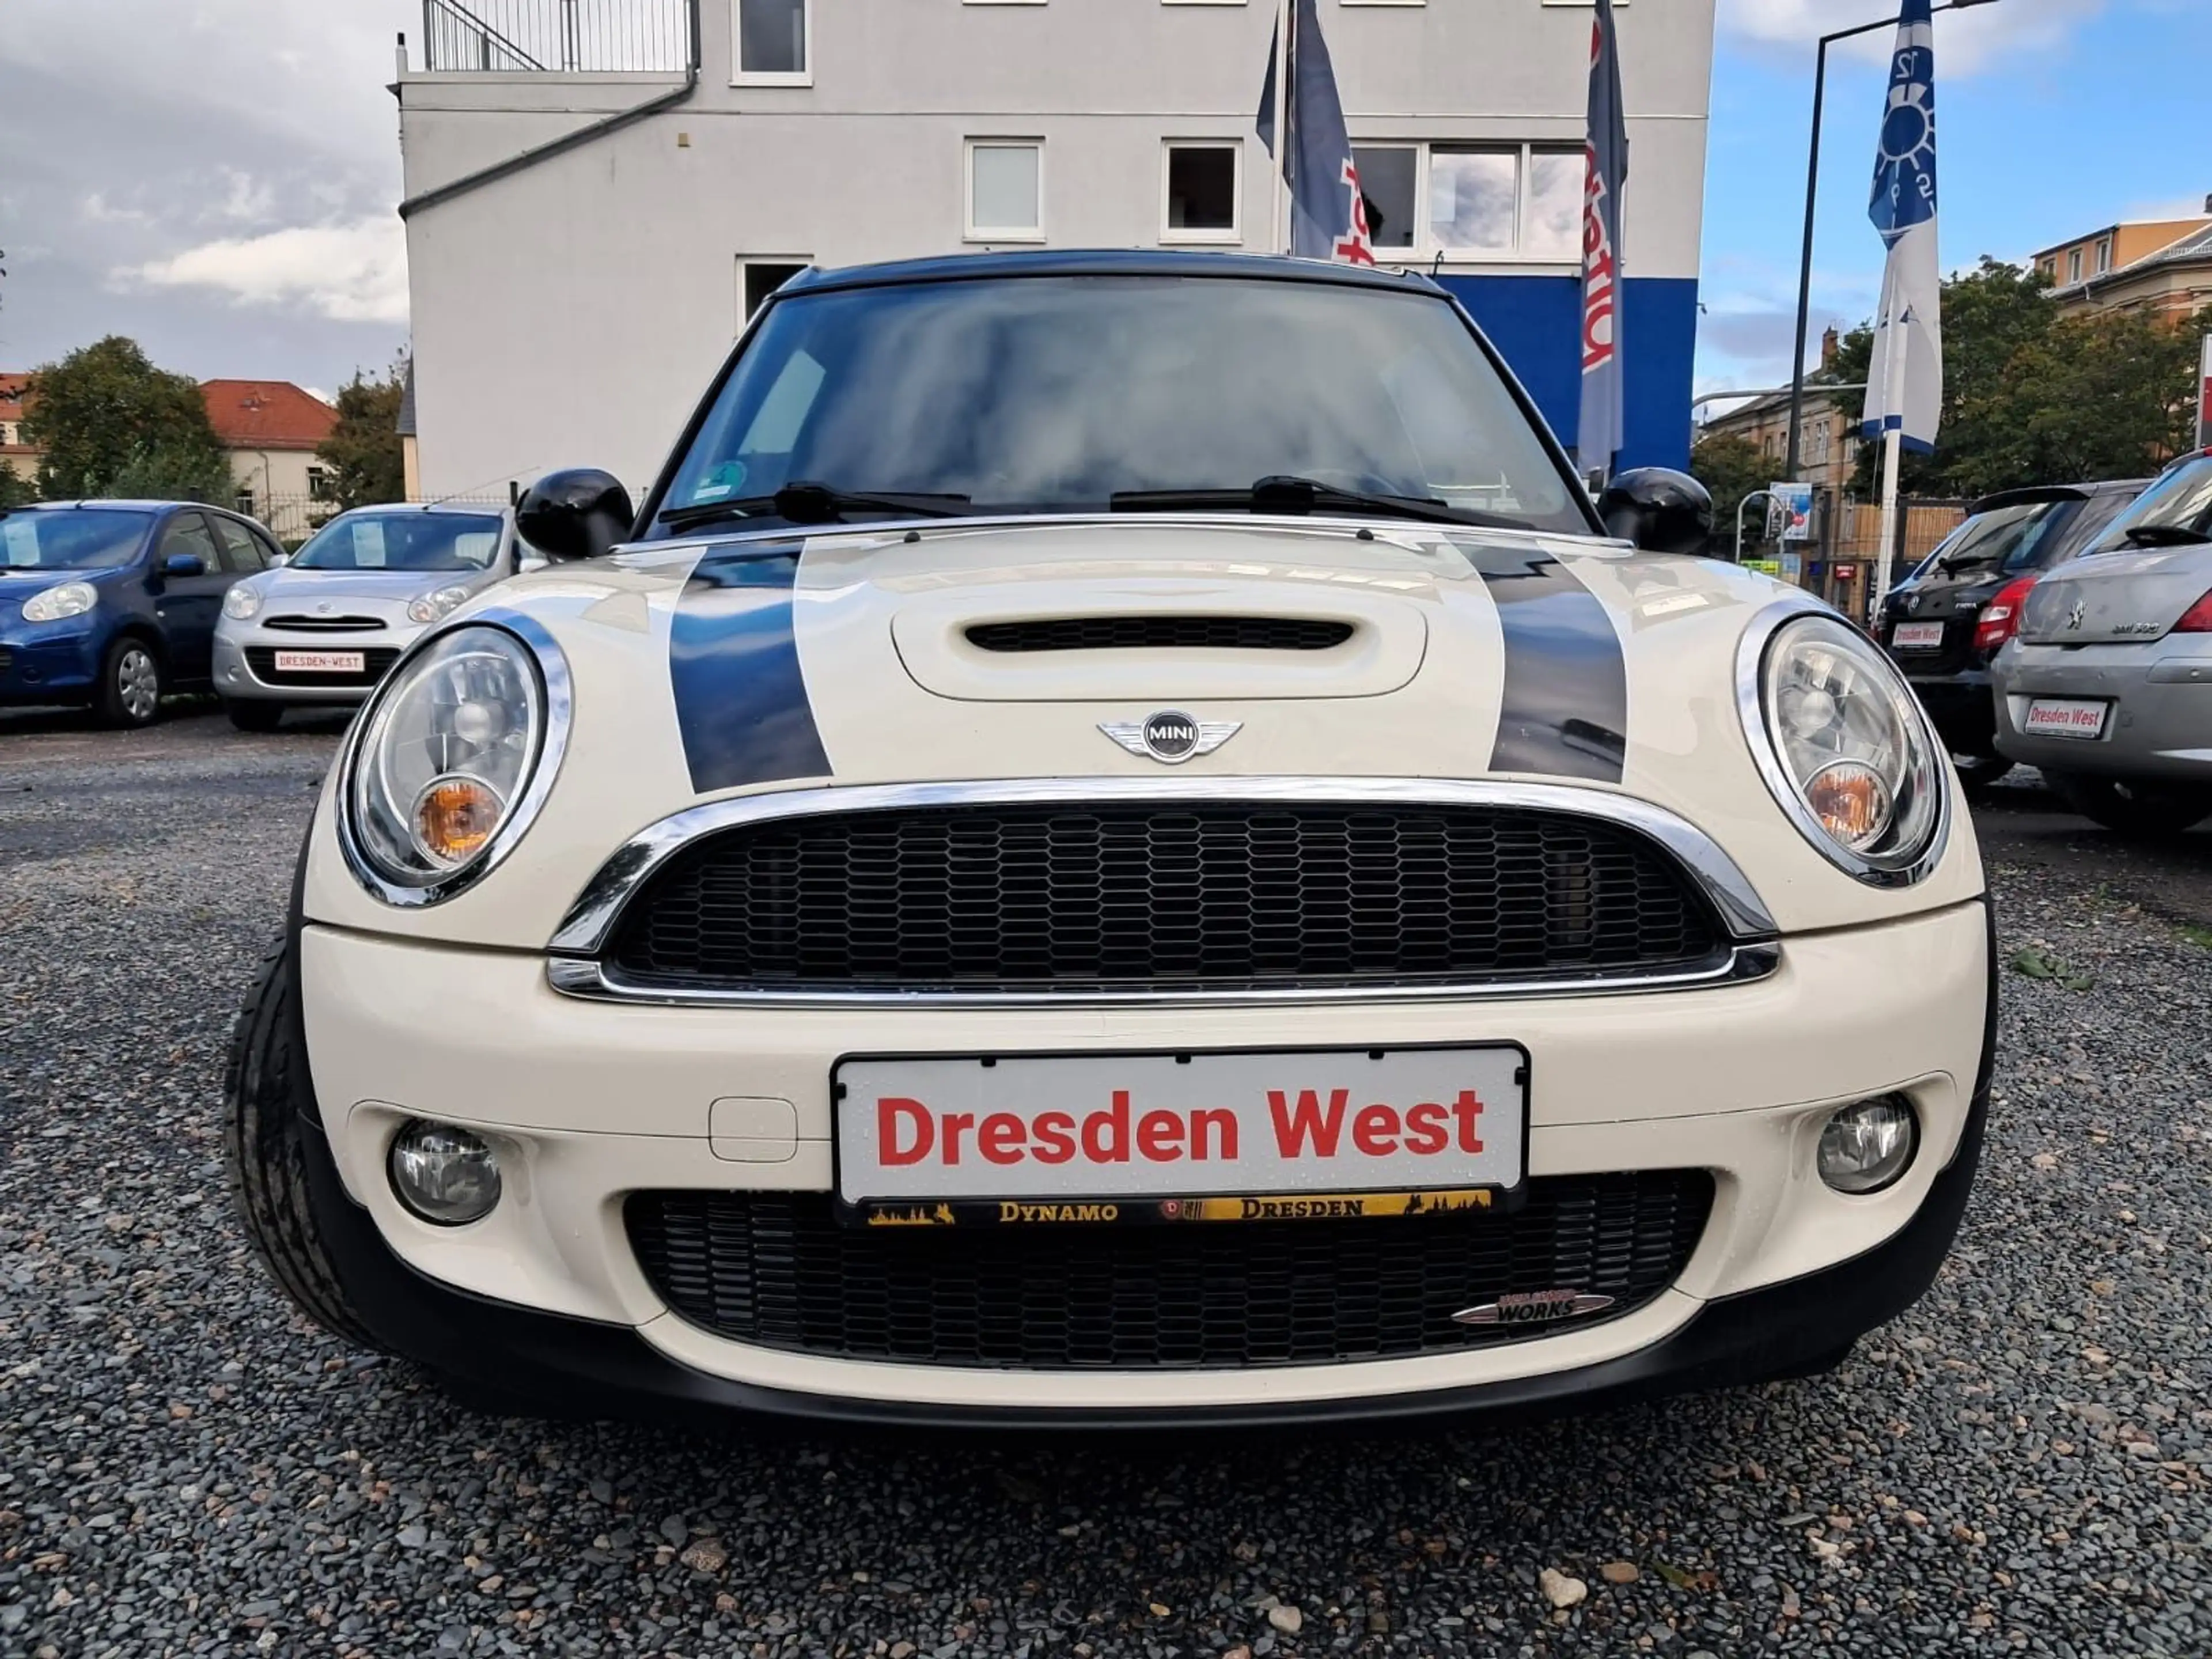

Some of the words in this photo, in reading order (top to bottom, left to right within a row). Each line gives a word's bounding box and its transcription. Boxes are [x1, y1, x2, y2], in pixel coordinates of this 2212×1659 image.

[280, 656, 359, 668] DRESDEN-WEST
[2031, 707, 2069, 724] Dresden
[2071, 708, 2100, 726] West
[1150, 725, 1193, 740] MINI
[877, 1090, 1238, 1166] Dresden
[1267, 1089, 1484, 1158] West
[999, 1201, 1118, 1222] DYNAMO
[1240, 1199, 1365, 1219] DRESDEN
[1498, 1299, 1575, 1321] WORKS
